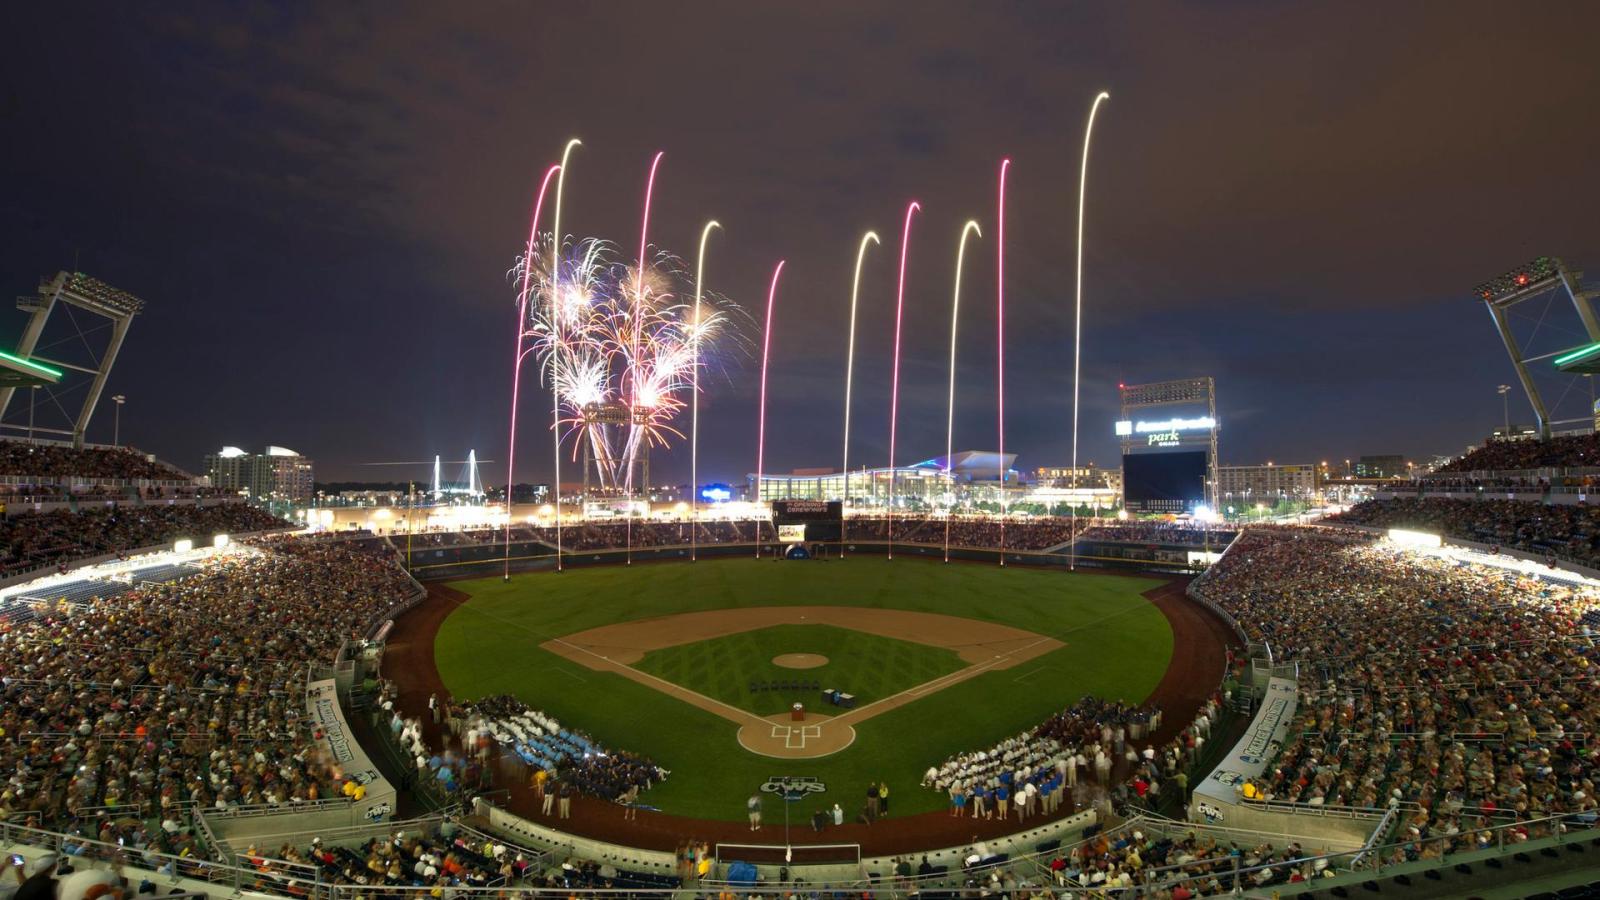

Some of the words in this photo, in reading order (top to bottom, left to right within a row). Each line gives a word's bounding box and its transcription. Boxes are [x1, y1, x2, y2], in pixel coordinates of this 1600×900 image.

[1148, 429, 1180, 446] park
[760, 782, 826, 792] CWS
[364, 805, 391, 819] CWS
[1197, 804, 1225, 821] CWS
